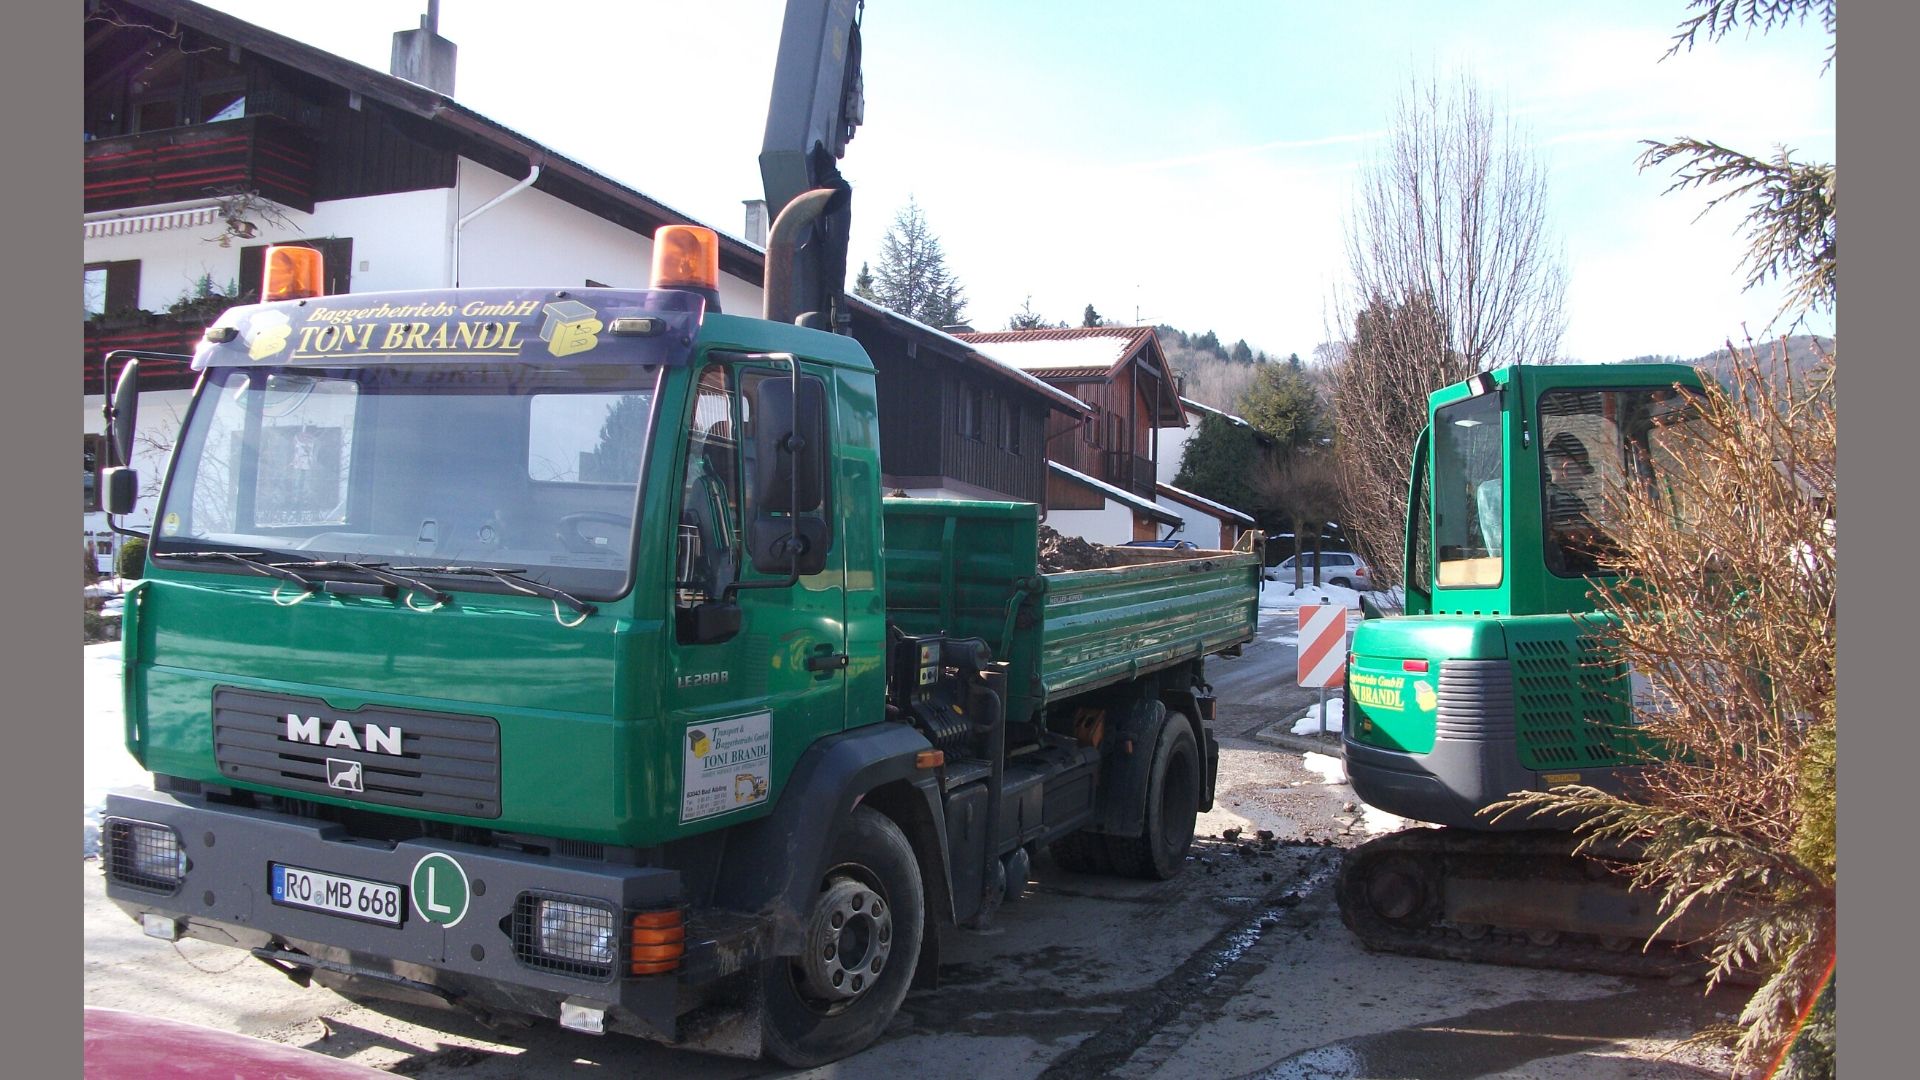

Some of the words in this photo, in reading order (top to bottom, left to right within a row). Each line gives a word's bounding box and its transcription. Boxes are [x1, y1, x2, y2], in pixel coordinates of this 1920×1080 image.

[306, 302, 457, 324] Baggerbetriebs
[462, 301, 540, 317] GmbH
[296, 323, 379, 352] TONI
[380, 321, 524, 349] BRANDL
[1361, 686, 1404, 707] BRANDL
[287, 714, 402, 756] MAN
[703, 750, 729, 769] TONI
[731, 744, 769, 763] BRANDL
[286, 872, 312, 902] RO
[325, 879, 351, 910] MB
[358, 886, 397, 918] 668
[429, 866, 451, 914] L
